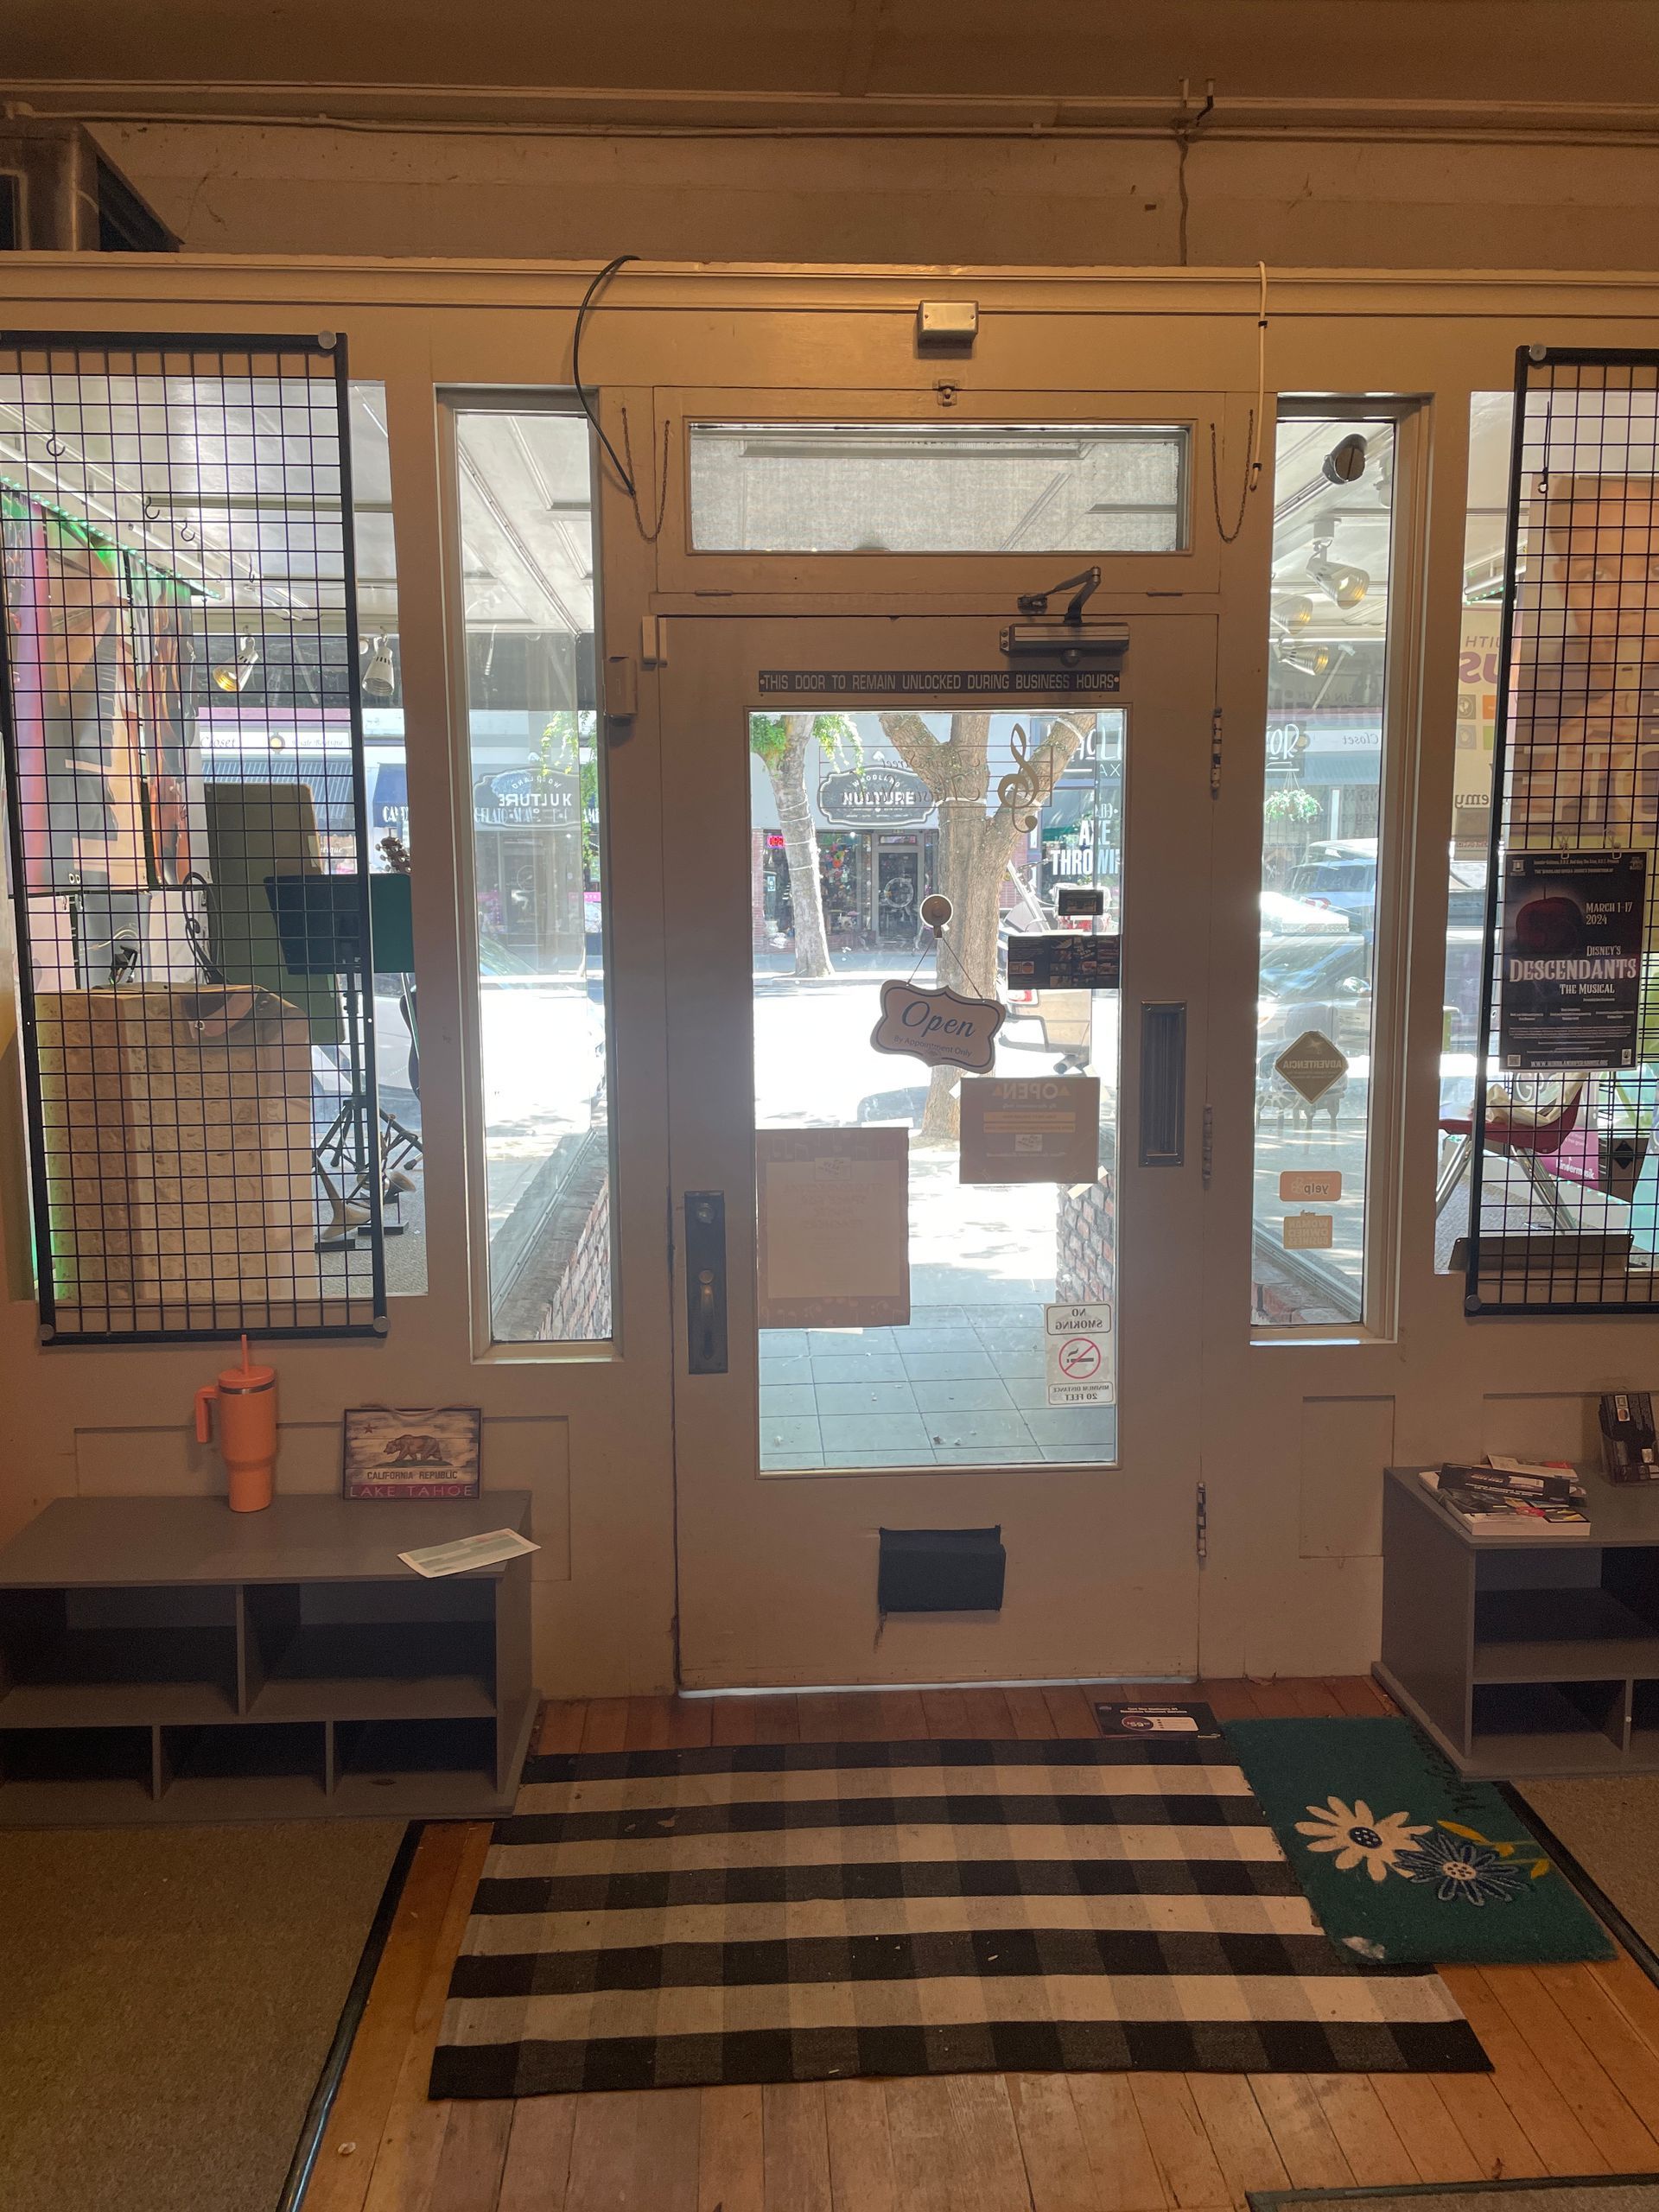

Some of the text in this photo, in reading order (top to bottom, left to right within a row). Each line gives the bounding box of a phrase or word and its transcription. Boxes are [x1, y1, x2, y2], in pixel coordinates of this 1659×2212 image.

[763, 673, 1115, 690] THIS DOOR TO REMAIN UNLOCKED DURING BUSINESS HOURS
[1078, 819, 1111, 846] AXE
[1586, 901, 1633, 914] MARCH 1-17
[1586, 913, 1607, 925] 2024
[1510, 958, 1637, 982] DESCENDANTS
[1559, 983, 1615, 995] THE MUSICAL
[901, 1001, 976, 1038] Open
[893, 1035, 973, 1058] By Appointment Only
[366, 1471, 459, 1480] CALIFORNIA REPUBLIC
[350, 1485, 473, 1497] LAKE TAHOE
